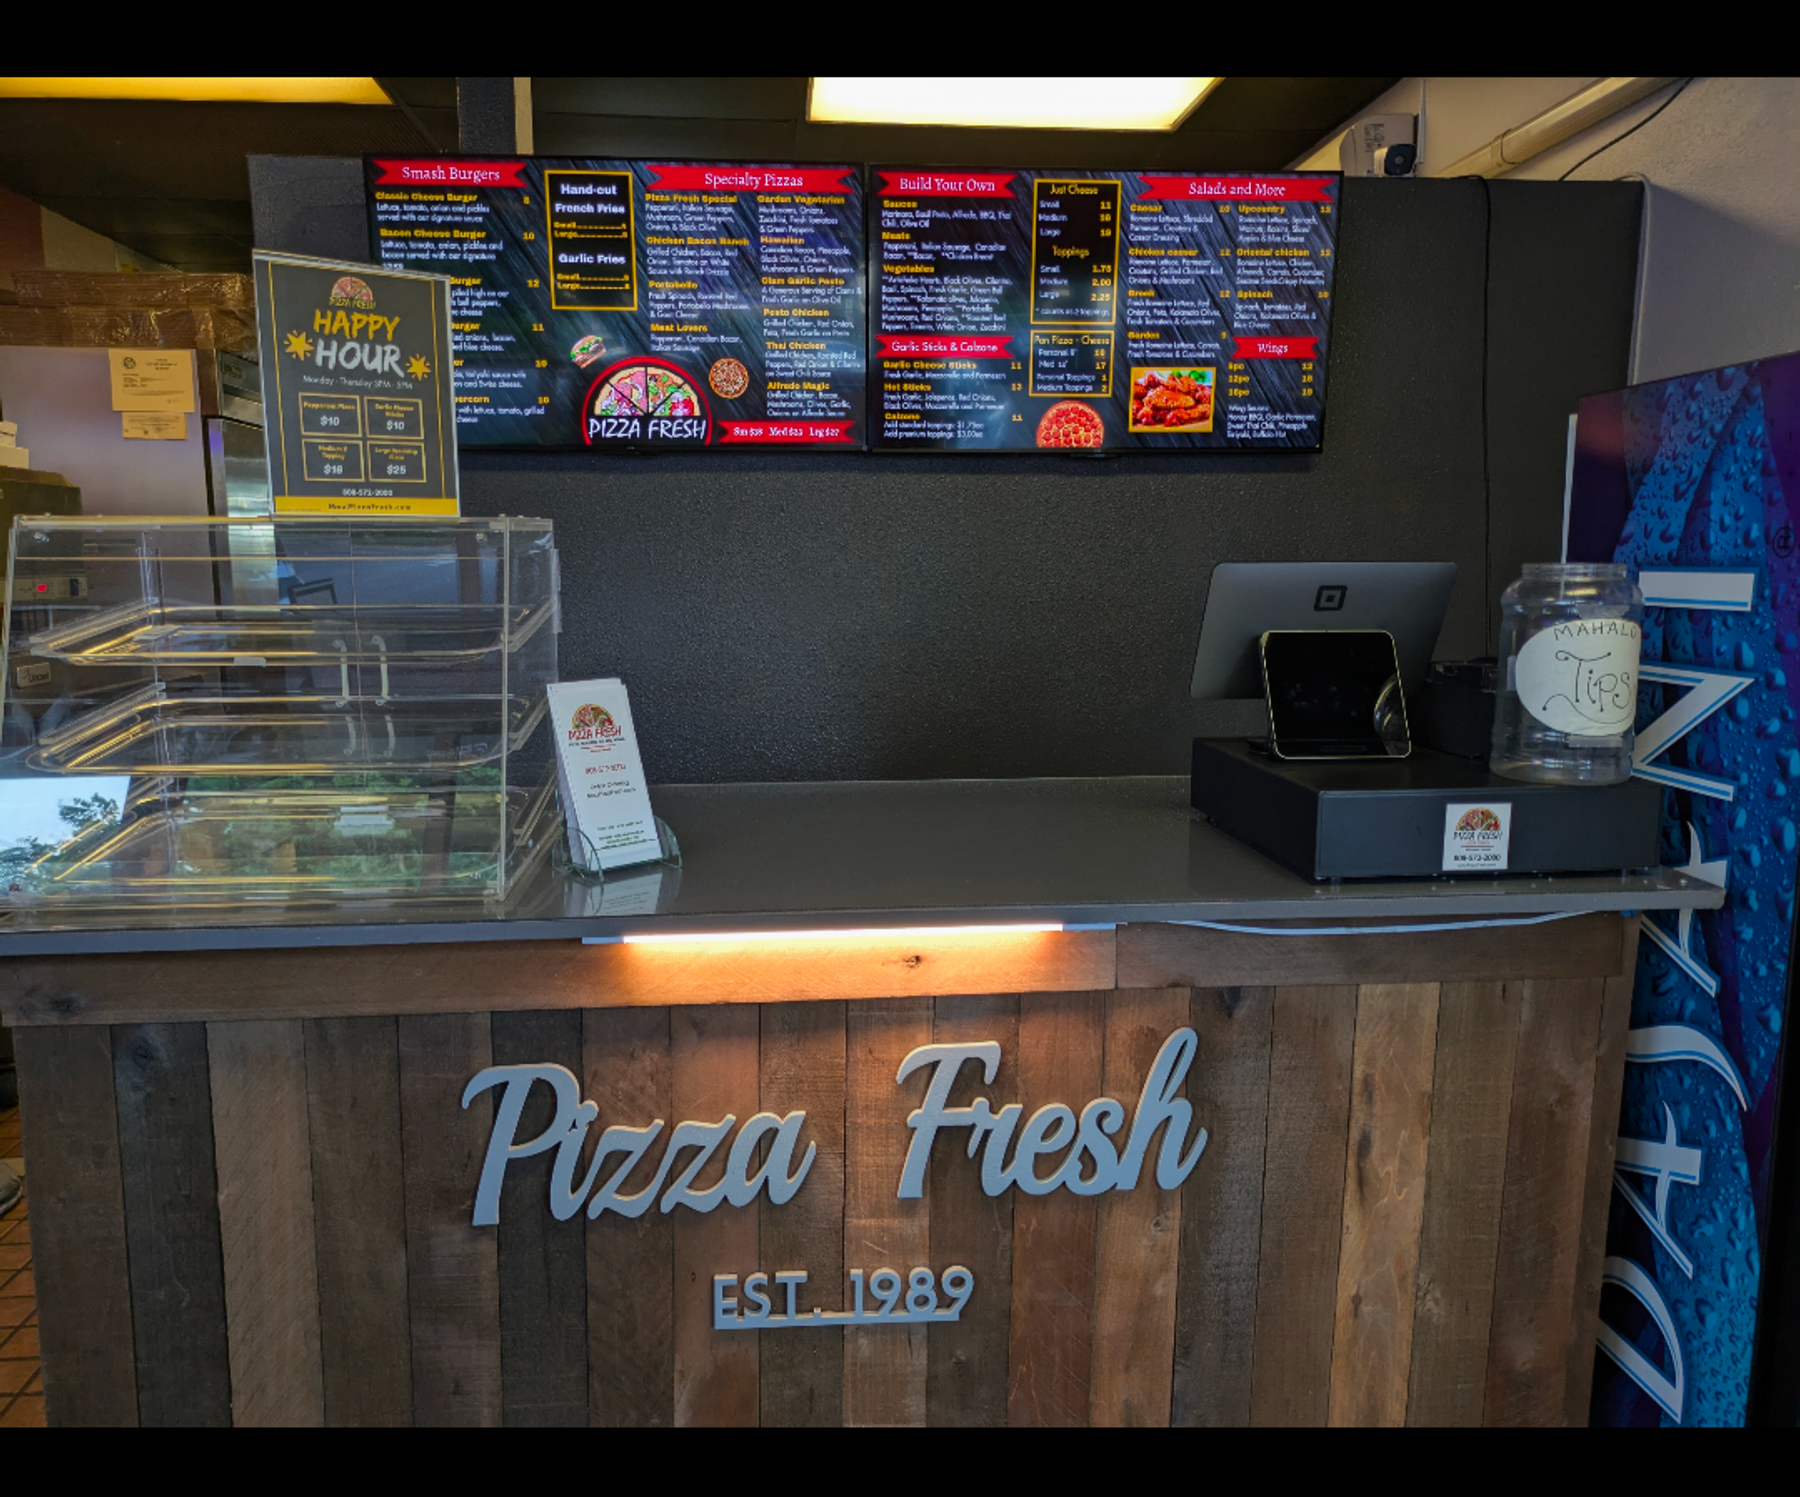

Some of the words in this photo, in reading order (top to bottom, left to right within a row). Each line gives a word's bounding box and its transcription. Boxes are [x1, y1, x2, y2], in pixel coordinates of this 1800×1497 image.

[402, 167, 446, 180] Smash
[450, 167, 501, 183] Burgers
[705, 172, 761, 189] Specialty
[764, 173, 803, 187] Pizzas
[900, 177, 932, 190] Build
[934, 179, 963, 191] Your
[966, 179, 995, 191] Own
[560, 184, 617, 195] Hand-cut
[1050, 184, 1066, 194] Just
[1068, 184, 1098, 194] Cheese
[1189, 183, 1227, 196] Salads
[1230, 183, 1252, 196] and
[1255, 184, 1286, 196] More
[375, 192, 409, 200] Classic
[411, 193, 445, 201] Cheese
[447, 194, 478, 202] Burger
[645, 193, 670, 202] Pizza
[673, 194, 699, 202] Fresh
[702, 195, 738, 204] Special
[757, 195, 791, 203] Garden
[794, 195, 845, 206] Vegetarian
[555, 203, 594, 213] French
[597, 203, 626, 214] Fries
[883, 200, 918, 208] Sauces
[1040, 200, 1060, 208] Small
[1130, 204, 1162, 212] Caesar
[1219, 205, 1230, 213] 10
[1238, 205, 1286, 214] Upcountry
[1320, 206, 1331, 214] 12
[1038, 213, 1068, 221] Medium
[380, 229, 411, 237] Bacon
[414, 229, 451, 237] Cheese
[453, 230, 486, 239] Burger
[523, 232, 535, 241] 10
[882, 232, 911, 240] Meats
[1040, 229, 1061, 237] Large
[647, 236, 684, 244] Chicken
[687, 237, 717, 245] Bacon
[720, 237, 749, 246] Ranch
[760, 236, 804, 244] Hawaiian
[1052, 245, 1089, 259] Toppings
[1129, 248, 1165, 256] Chicken
[1237, 248, 1273, 256] Oriental
[1320, 249, 1331, 257] 12
[558, 254, 594, 263] Garlic
[597, 255, 626, 264] Fries
[883, 265, 935, 274] Vegetables
[1040, 265, 1061, 273] Small
[1092, 264, 1112, 273] 1.75
[527, 279, 539, 288] 12
[649, 280, 698, 289] Portobello
[1091, 278, 1111, 287] 2.00
[1039, 289, 1060, 299] Large
[1091, 293, 1111, 302] 2.25
[1128, 289, 1155, 297] Greek
[1220, 290, 1230, 298] 12
[1237, 290, 1273, 299] Spinach
[329, 297, 350, 307] PIZZA
[352, 298, 377, 310] FRESH
[764, 308, 789, 316] Pesto
[792, 308, 829, 317] Chicken
[313, 309, 401, 342] HAPPY
[532, 323, 544, 332] 11
[650, 324, 674, 332] Meat
[677, 324, 708, 332] Lovers
[1034, 335, 1049, 345] Pan
[1052, 335, 1073, 345] Pizza
[1081, 335, 1110, 345] Cheese
[765, 341, 786, 349] Thai
[891, 341, 919, 352] Garlic
[922, 341, 947, 352] Sticks
[950, 342, 958, 352] &
[960, 341, 998, 352] Calzone
[1257, 342, 1288, 356] Wings
[315, 338, 405, 378] HOUR
[535, 359, 548, 368] 10
[883, 361, 911, 369] Garlic
[913, 361, 946, 369] Cheese
[949, 361, 977, 369] Sticks
[1010, 362, 1022, 370] 11
[1095, 362, 1106, 370] 17
[1302, 362, 1313, 370] 12
[303, 375, 334, 386] Monday
[339, 377, 373, 388] Thursday
[767, 382, 800, 390] Alfredo
[802, 382, 830, 391] Magic
[884, 383, 901, 391] Hot
[903, 383, 931, 391] Sticks
[1064, 384, 1093, 392] Toppings
[538, 396, 550, 404] 10
[303, 401, 336, 410] Pepperoni
[320, 415, 340, 427] $10
[386, 420, 405, 431] $10
[589, 418, 641, 439] PIZZA
[648, 419, 706, 439] FRESH
[733, 427, 748, 436] Sm
[769, 427, 788, 436] Med
[323, 463, 343, 475] $18
[387, 464, 407, 476] $25
[1553, 621, 1637, 640] MAHALO
[1555, 650, 1631, 713] Tips
[568, 729, 593, 741] PIZZA
[595, 725, 621, 738] FRESH
[1453, 831, 1475, 841] PIZZA
[1477, 830, 1503, 841] FRESH
[461, 1062, 816, 1226] Pizza
[895, 1027, 1207, 1198] Fresh
[714, 1271, 823, 1324] EST.
[849, 1265, 974, 1323] 1989
